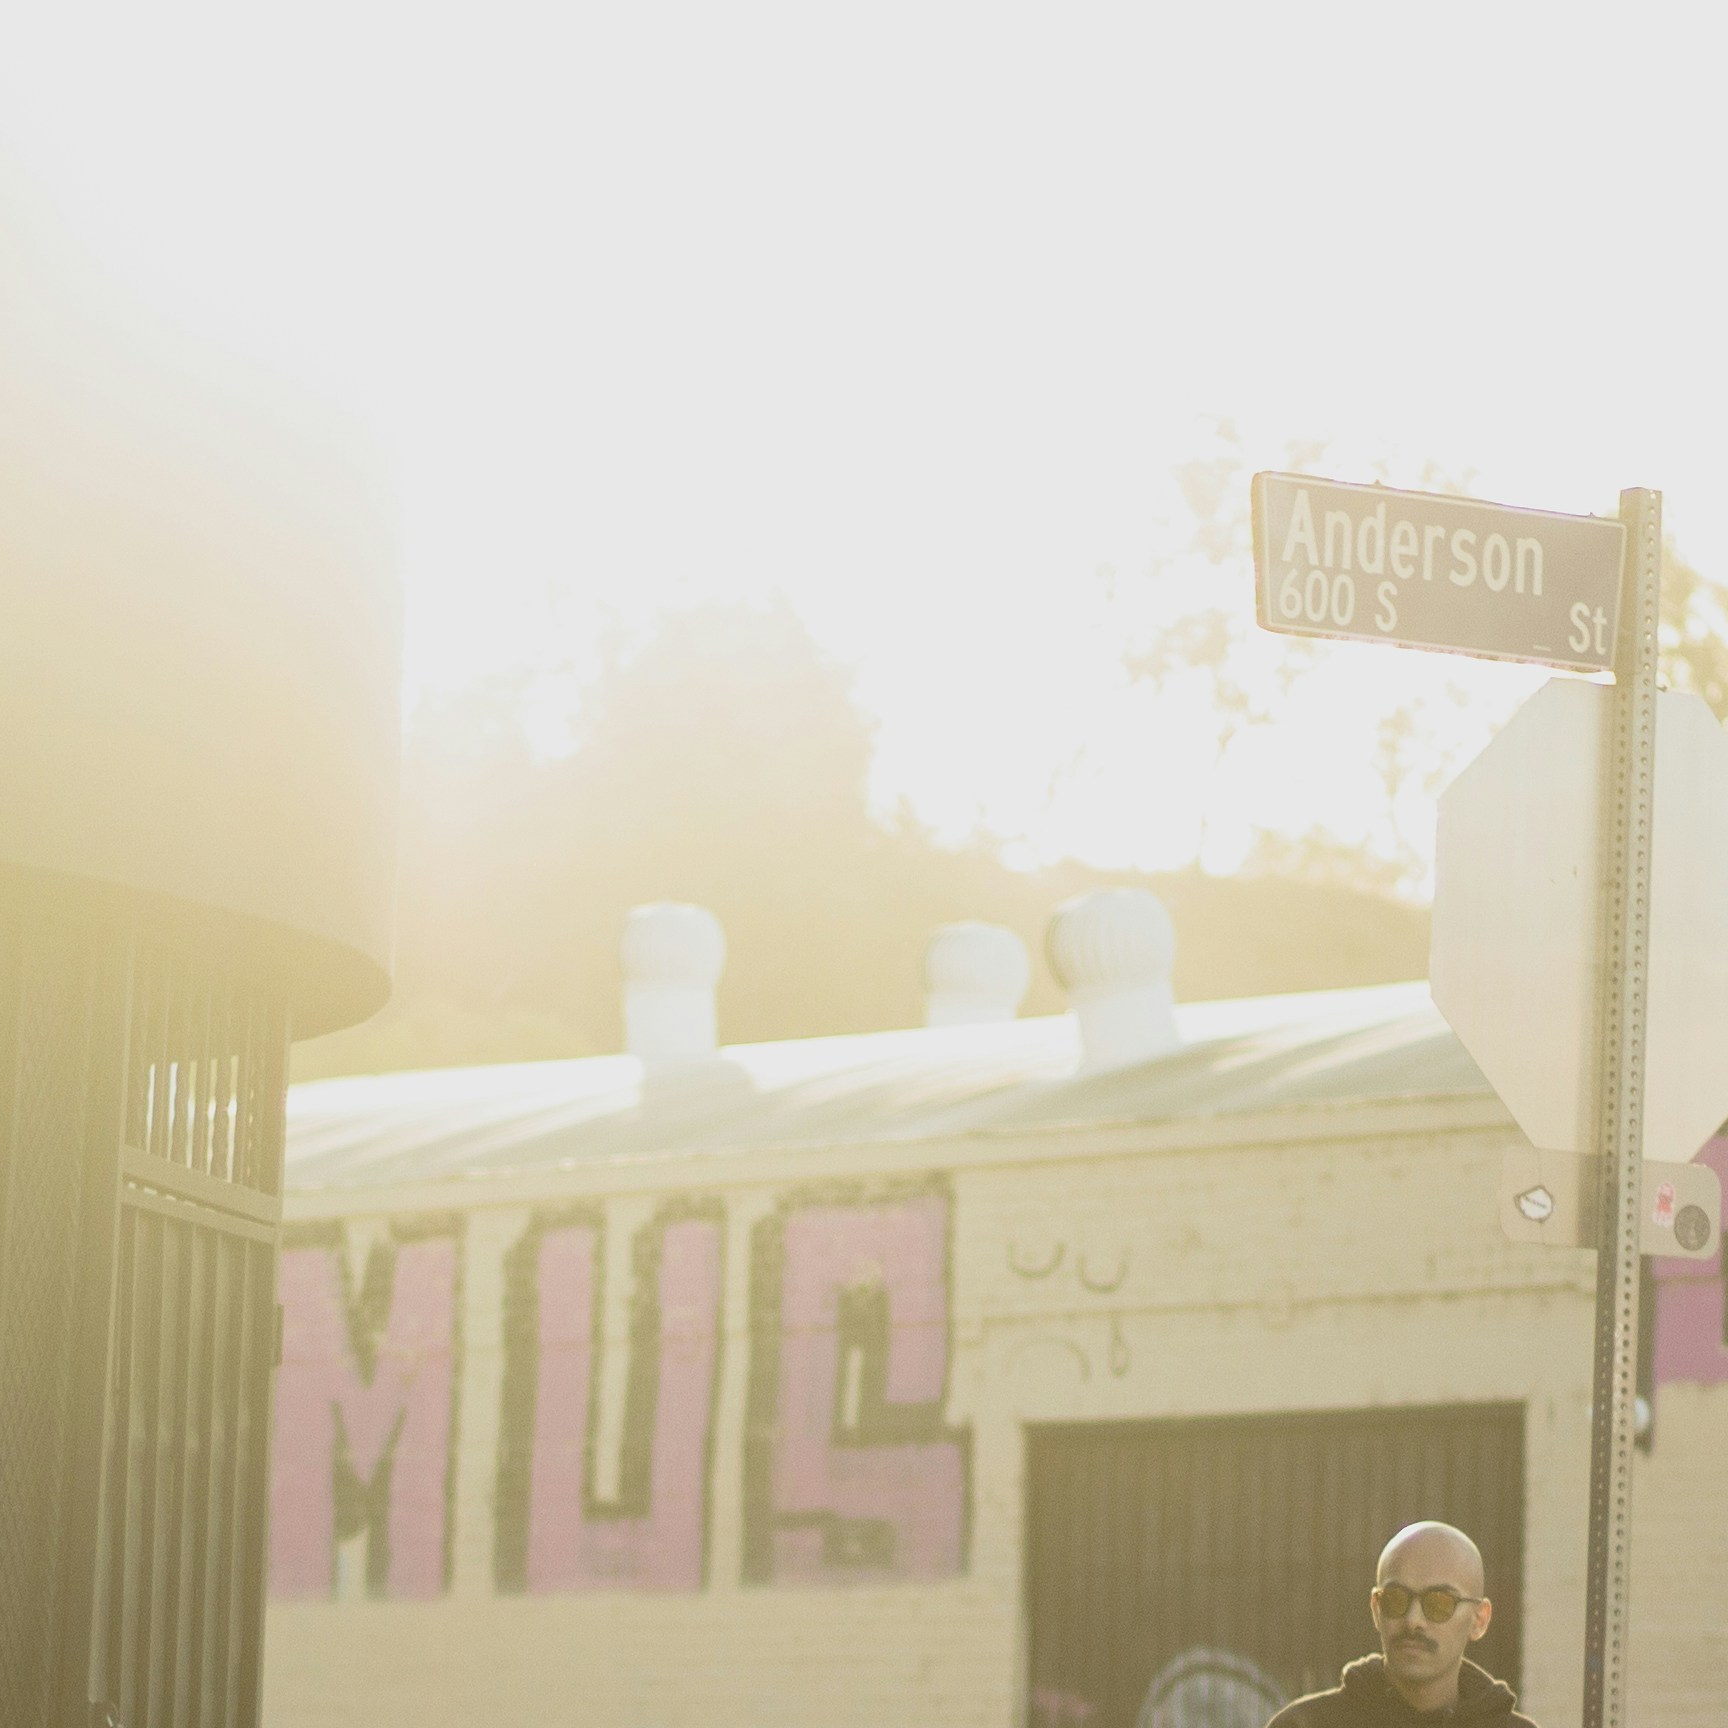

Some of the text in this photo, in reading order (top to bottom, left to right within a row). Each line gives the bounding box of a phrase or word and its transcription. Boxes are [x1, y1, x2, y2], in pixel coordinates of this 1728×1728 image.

[1281, 488, 1544, 597] Anderson
[1278, 568, 1609, 656] 600 S St
